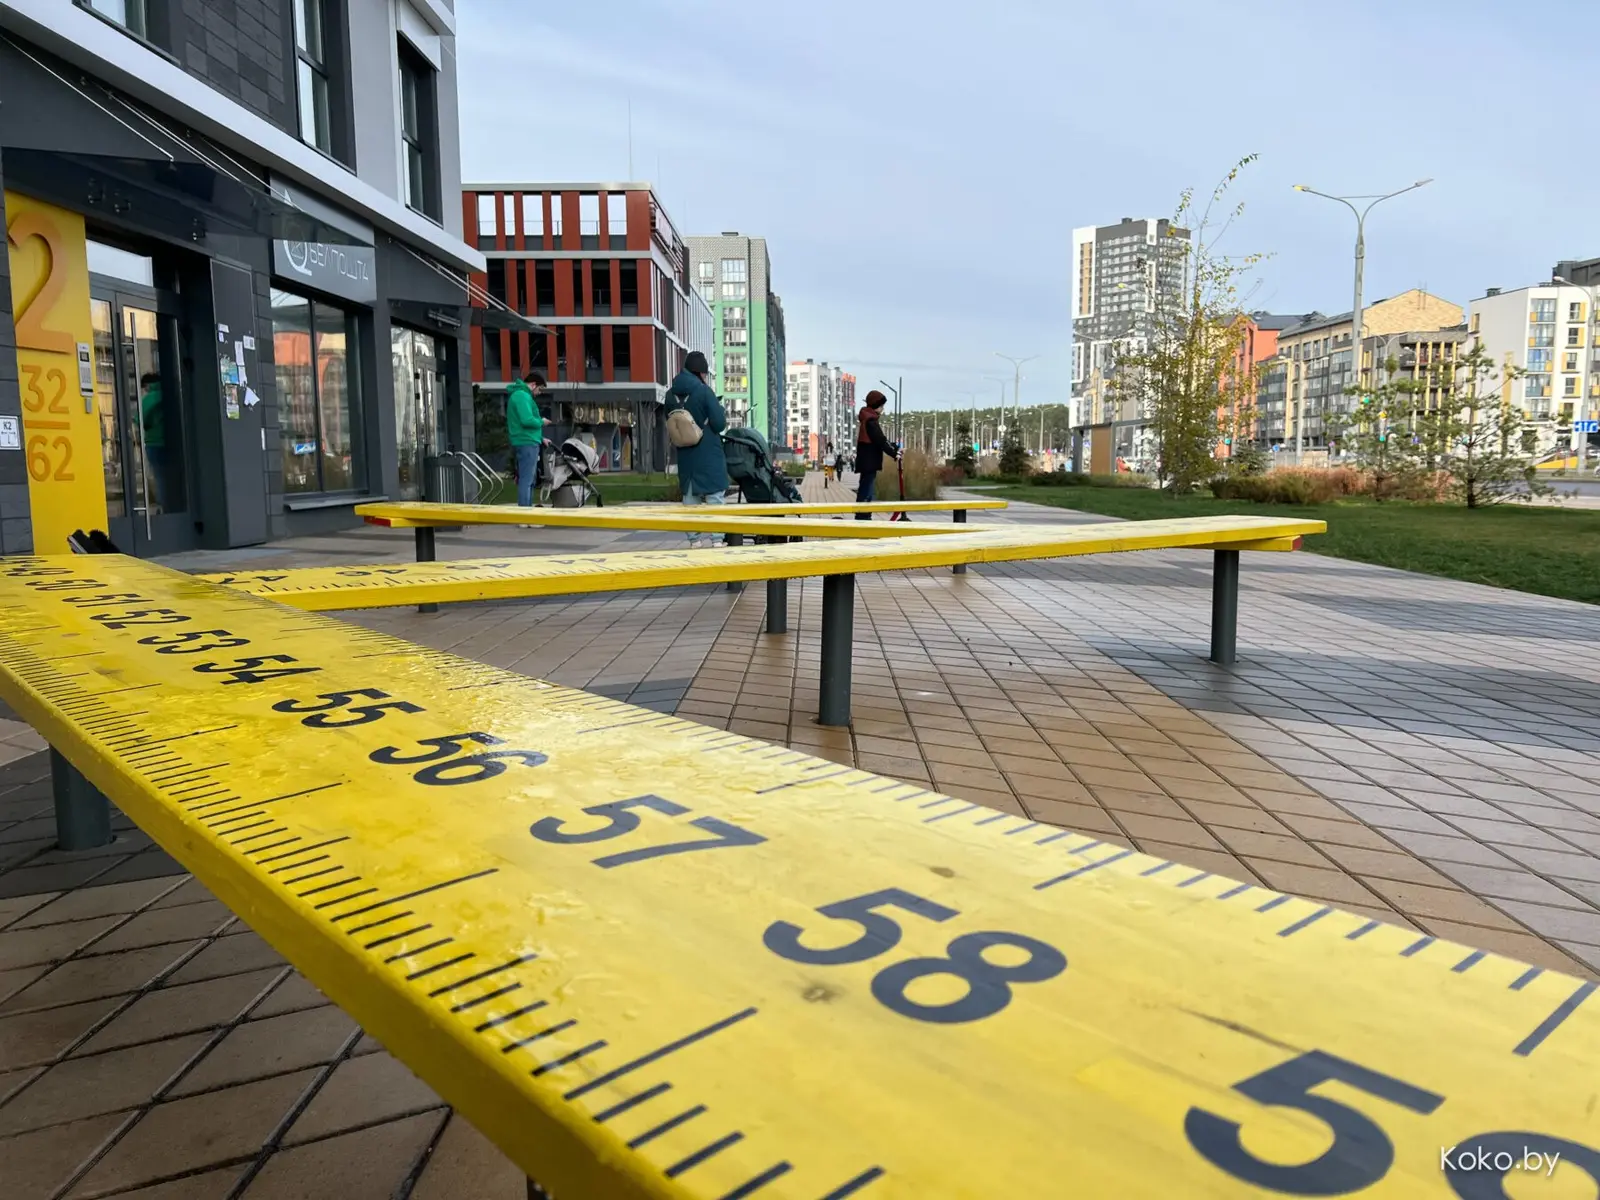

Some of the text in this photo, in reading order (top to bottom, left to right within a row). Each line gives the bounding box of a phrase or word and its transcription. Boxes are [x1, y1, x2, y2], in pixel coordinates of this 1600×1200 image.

[8, 211, 76, 354] 2
[21, 364, 70, 415] 32
[27, 434, 75, 482] 62
[25, 578, 109, 592] 50
[62, 593, 155, 609] 51
[89, 608, 192, 630] 52
[137, 629, 251, 654] 53
[192, 654, 322, 685] 54
[271, 688, 426, 728] 55
[369, 731, 549, 787] 56
[530, 794, 768, 869] 57
[763, 887, 1068, 1024] 58
